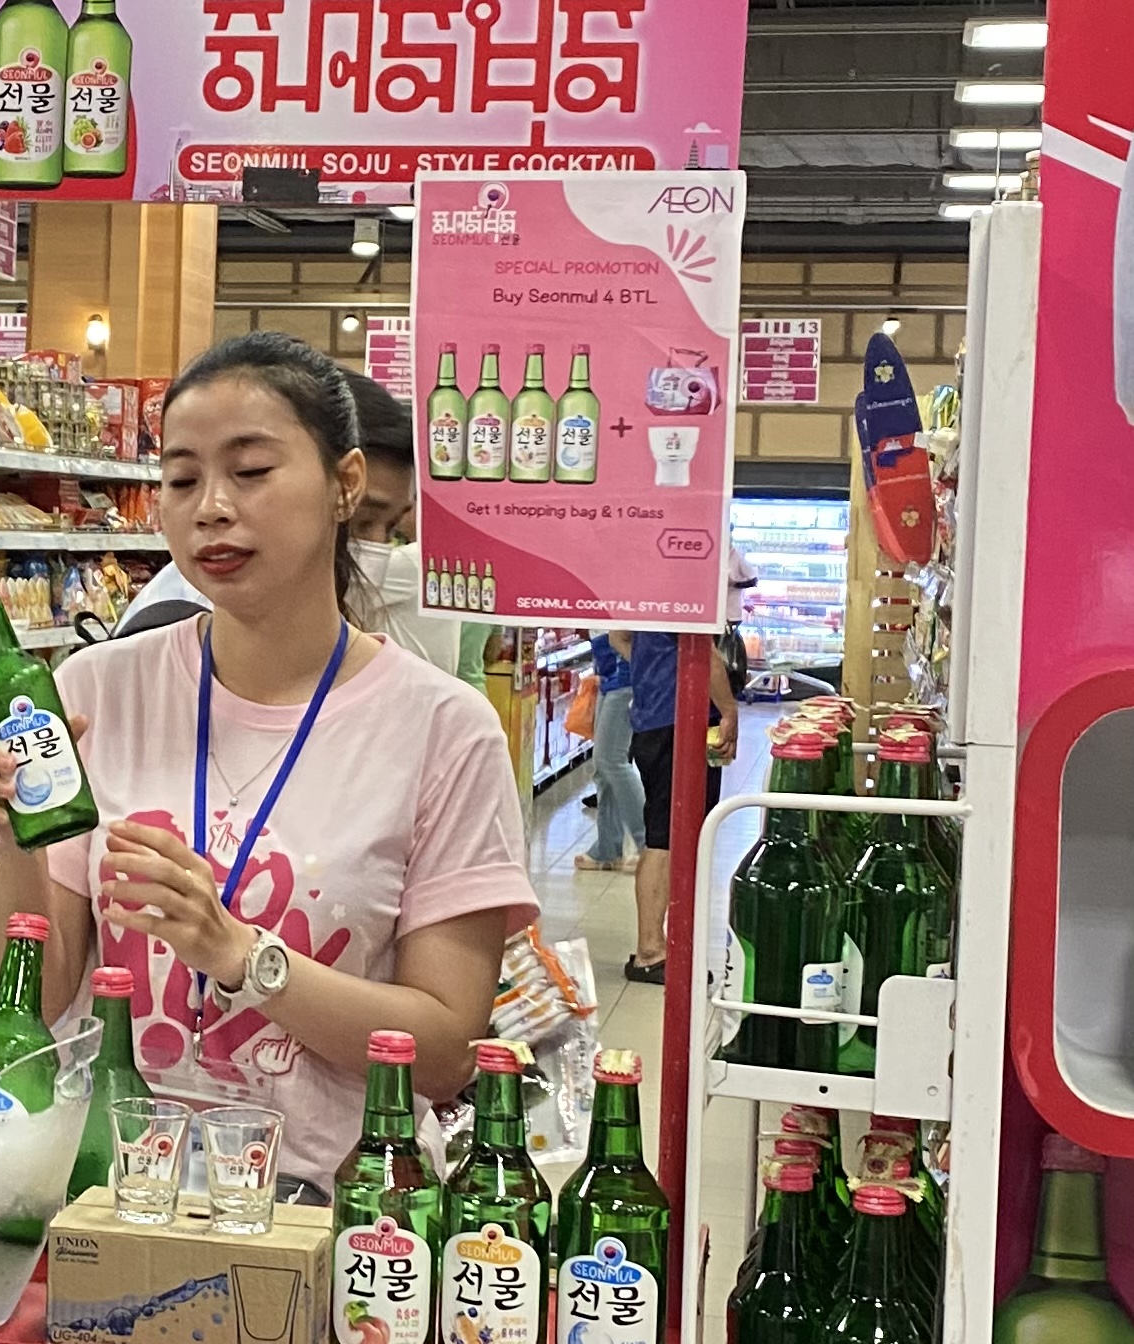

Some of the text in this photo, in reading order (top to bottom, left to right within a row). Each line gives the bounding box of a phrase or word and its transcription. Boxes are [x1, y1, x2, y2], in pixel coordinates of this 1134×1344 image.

[2, 69, 51, 81] SEONMUL
[69, 86, 121, 114] 선물
[322, 154, 391, 175] SOJU
[417, 154, 500, 171] STYLE
[431, 233, 493, 246] SEONMUL
[494, 260, 659, 275] SPECIAL PROMOTION
[492, 288, 658, 306] Buy Seonmul 4 BTL
[798, 322, 819, 334] 13
[432, 426, 461, 443] 선물
[472, 426, 503, 444] 선물
[515, 427, 548, 446] 선물
[561, 428, 593, 447] 선물
[466, 502, 665, 521] Get 1 shopping bag & 1 Glass
[667, 536, 703, 552] Free
[516, 597, 572, 610] SEONMUL
[638, 600, 670, 614] STYE
[673, 602, 705, 615] SOJU
[6, 727, 64, 769] 선물
[56, 1236, 99, 1249] UNION
[352, 1236, 411, 1254] SEONMUL
[460, 1243, 518, 1262] SEONMUL
[345, 1253, 419, 1303] 선물
[574, 1262, 638, 1283] SEONMUL
[453, 1261, 527, 1311] 선물
[568, 1279, 646, 1326] 선물
